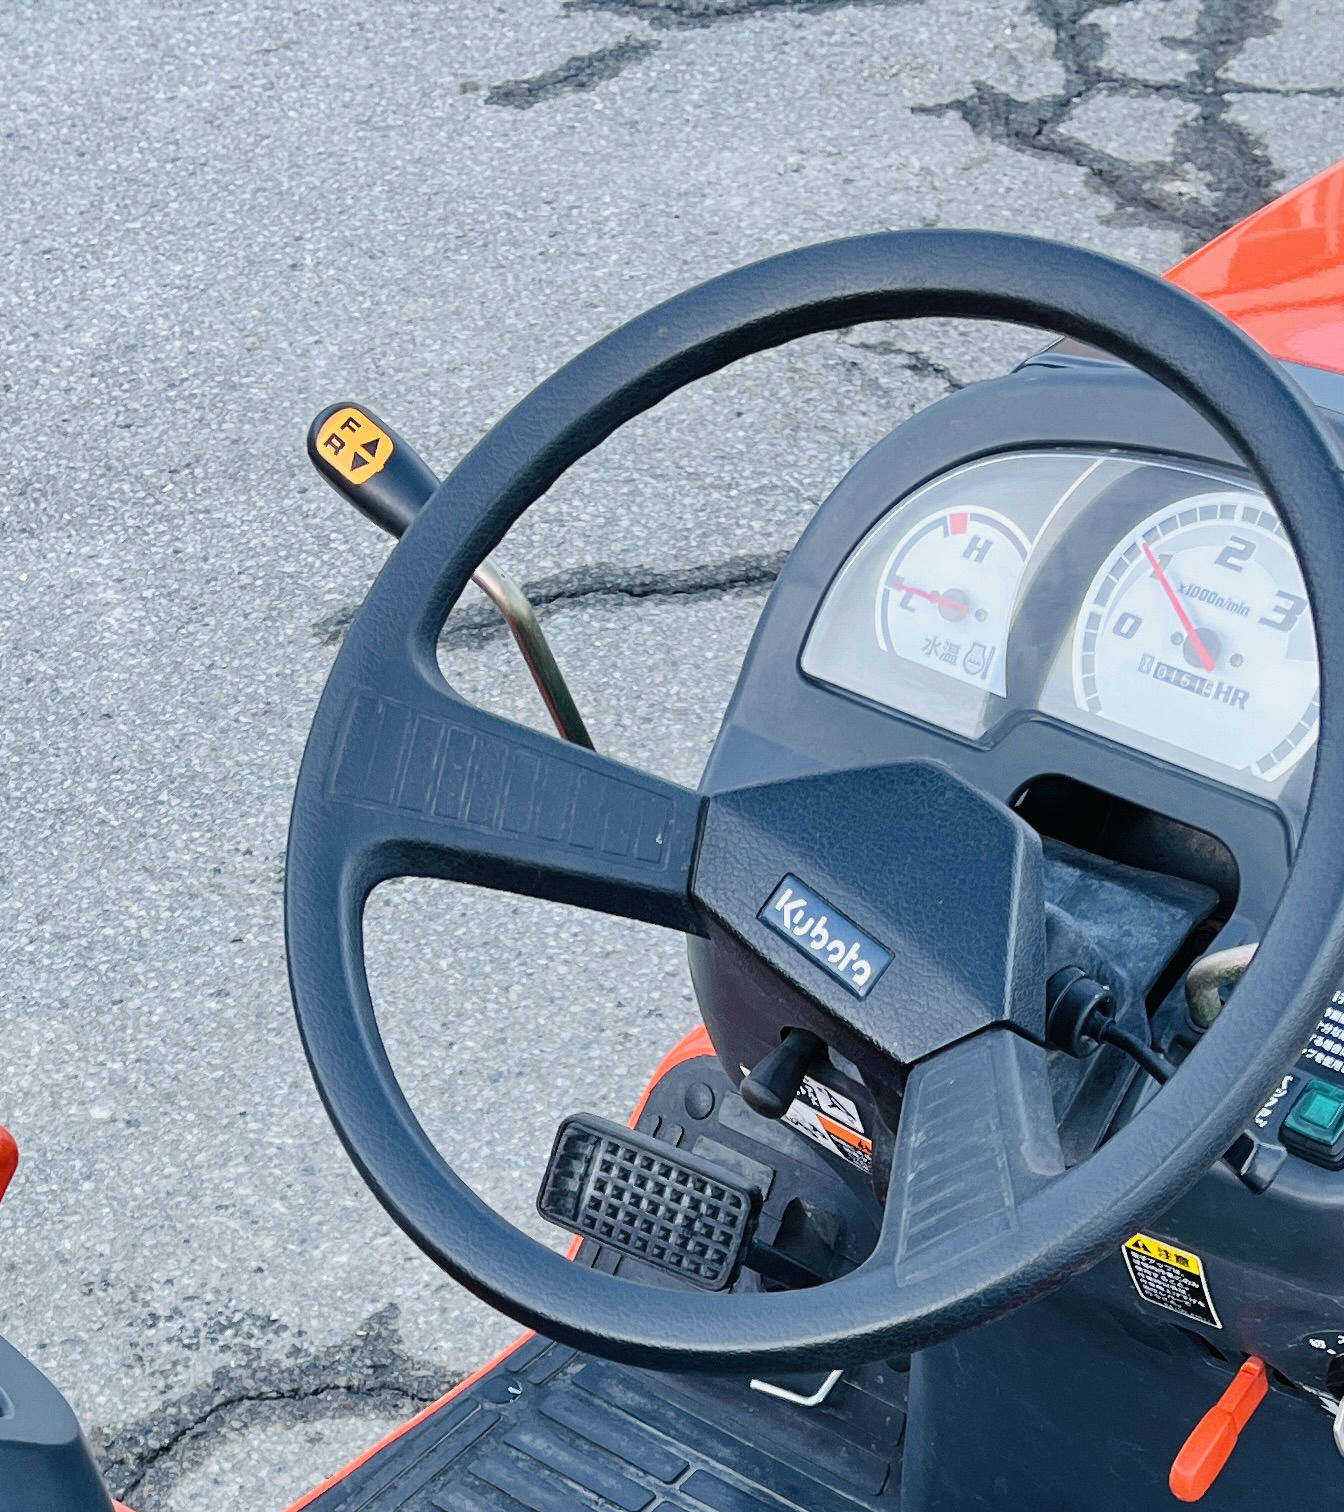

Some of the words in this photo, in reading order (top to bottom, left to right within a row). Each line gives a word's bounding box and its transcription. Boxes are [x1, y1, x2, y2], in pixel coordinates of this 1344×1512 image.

[962, 535, 993, 563] H
[1214, 535, 1257, 573] 2
[1149, 554, 1174, 580] 1
[1112, 611, 1143, 640] 0
[1257, 589, 1309, 633] 3
[921, 634, 961, 666] 水温
[1213, 680, 1250, 710] HR
[775, 888, 873, 987] Kubota
